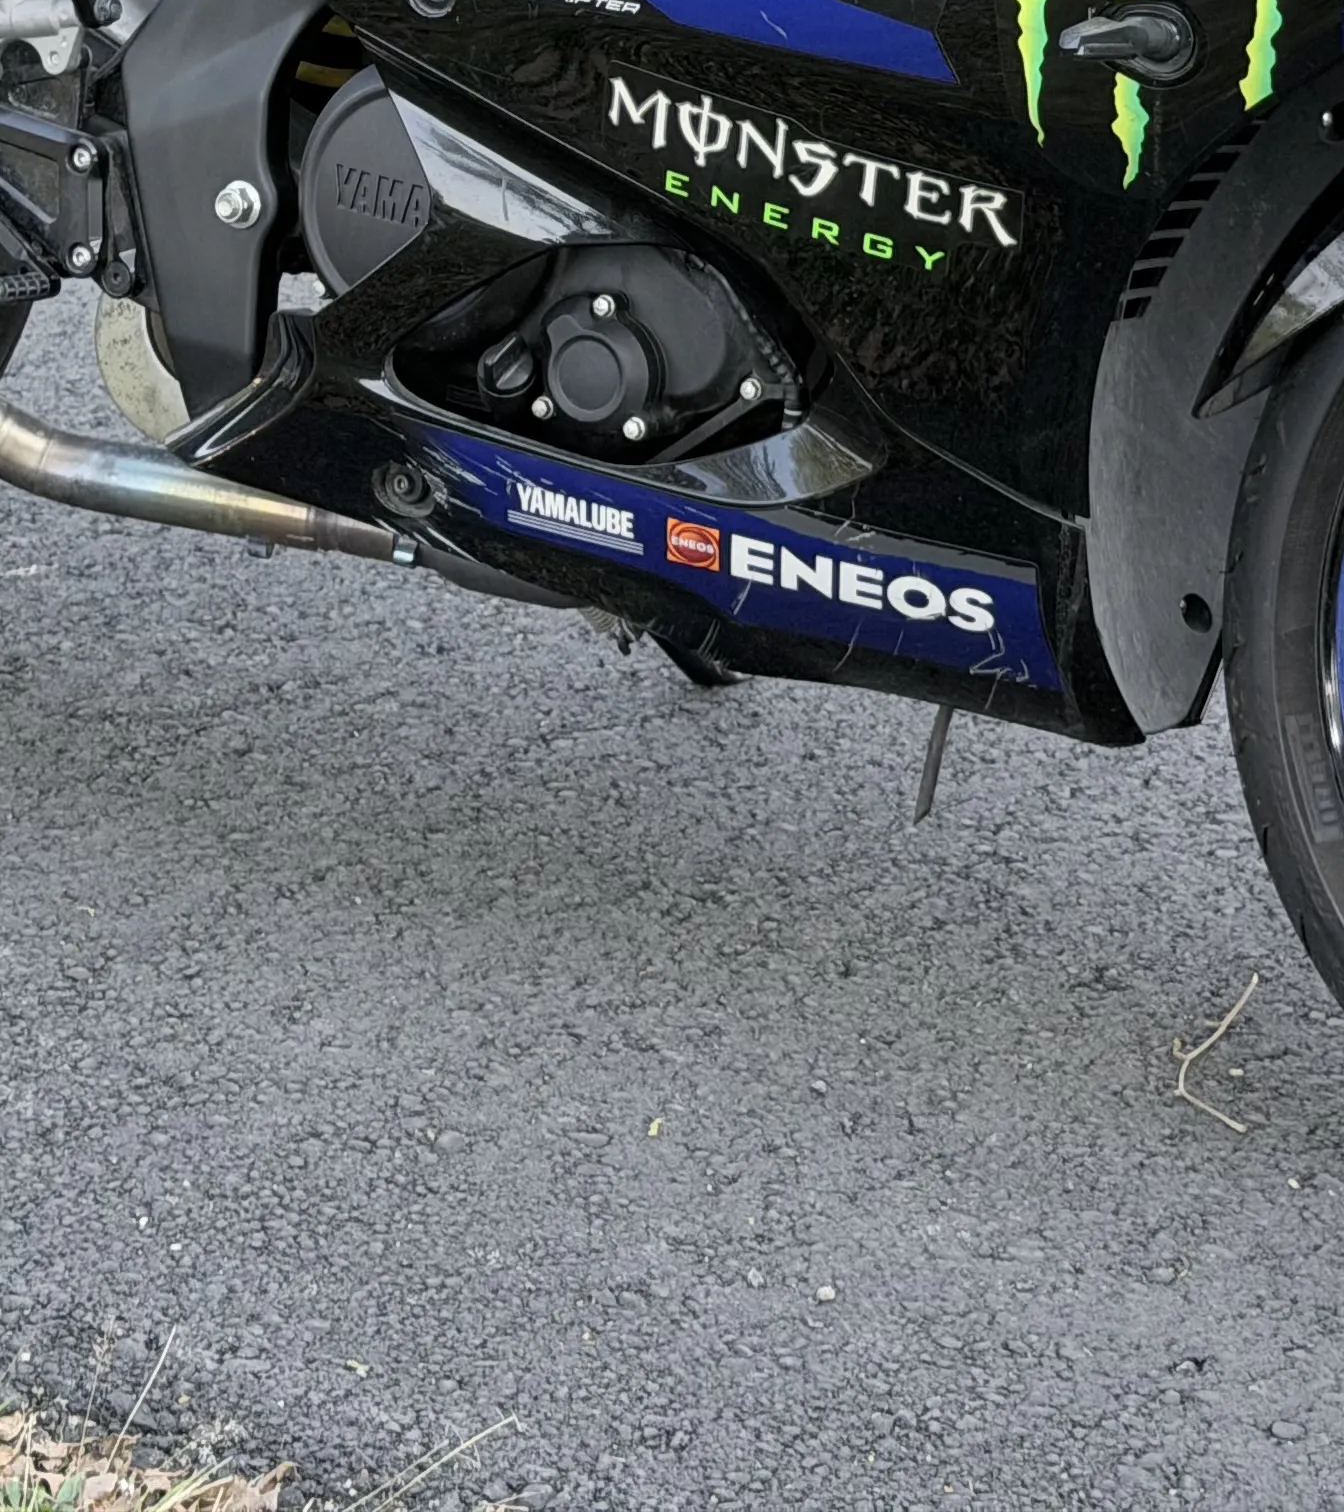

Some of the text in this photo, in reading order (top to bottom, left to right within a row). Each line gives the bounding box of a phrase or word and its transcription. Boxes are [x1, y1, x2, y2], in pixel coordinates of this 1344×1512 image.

[336, 163, 429, 228] YAMA
[608, 76, 1018, 248] MONSTER
[665, 170, 945, 271] ENERGY
[516, 483, 635, 540] YAMALUBE
[671, 535, 716, 555] ENEOS
[730, 533, 995, 633] ENEOS
